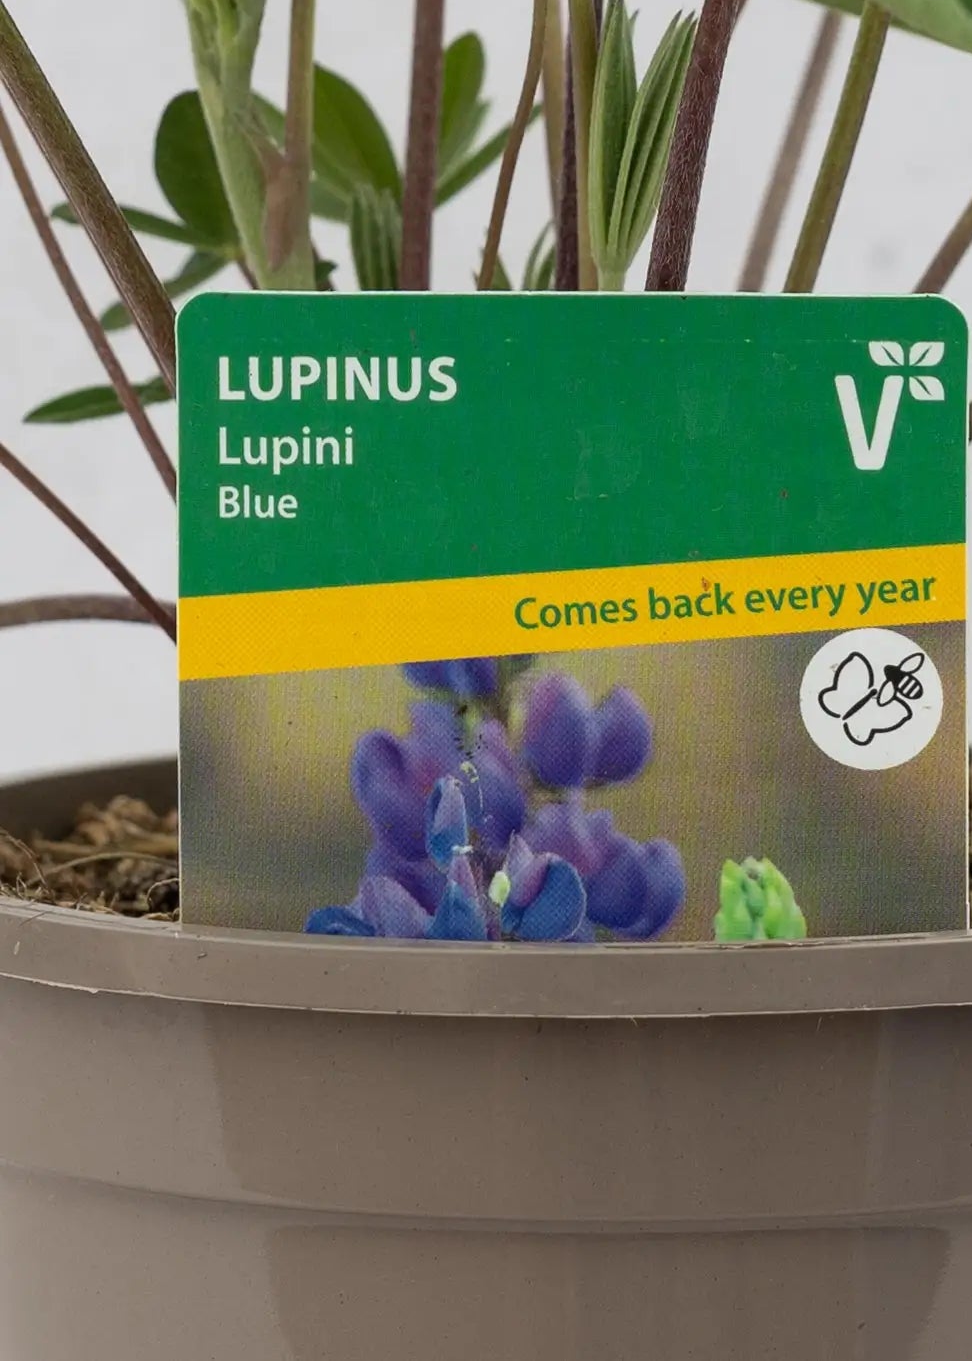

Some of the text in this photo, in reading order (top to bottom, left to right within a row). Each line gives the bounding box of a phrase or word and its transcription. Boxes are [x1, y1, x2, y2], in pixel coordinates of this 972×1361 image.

[217, 356, 458, 401] LUPINUS
[217, 426, 355, 474] Lupini
[217, 485, 299, 520] Blue
[514, 573, 937, 630] Comes back every year
